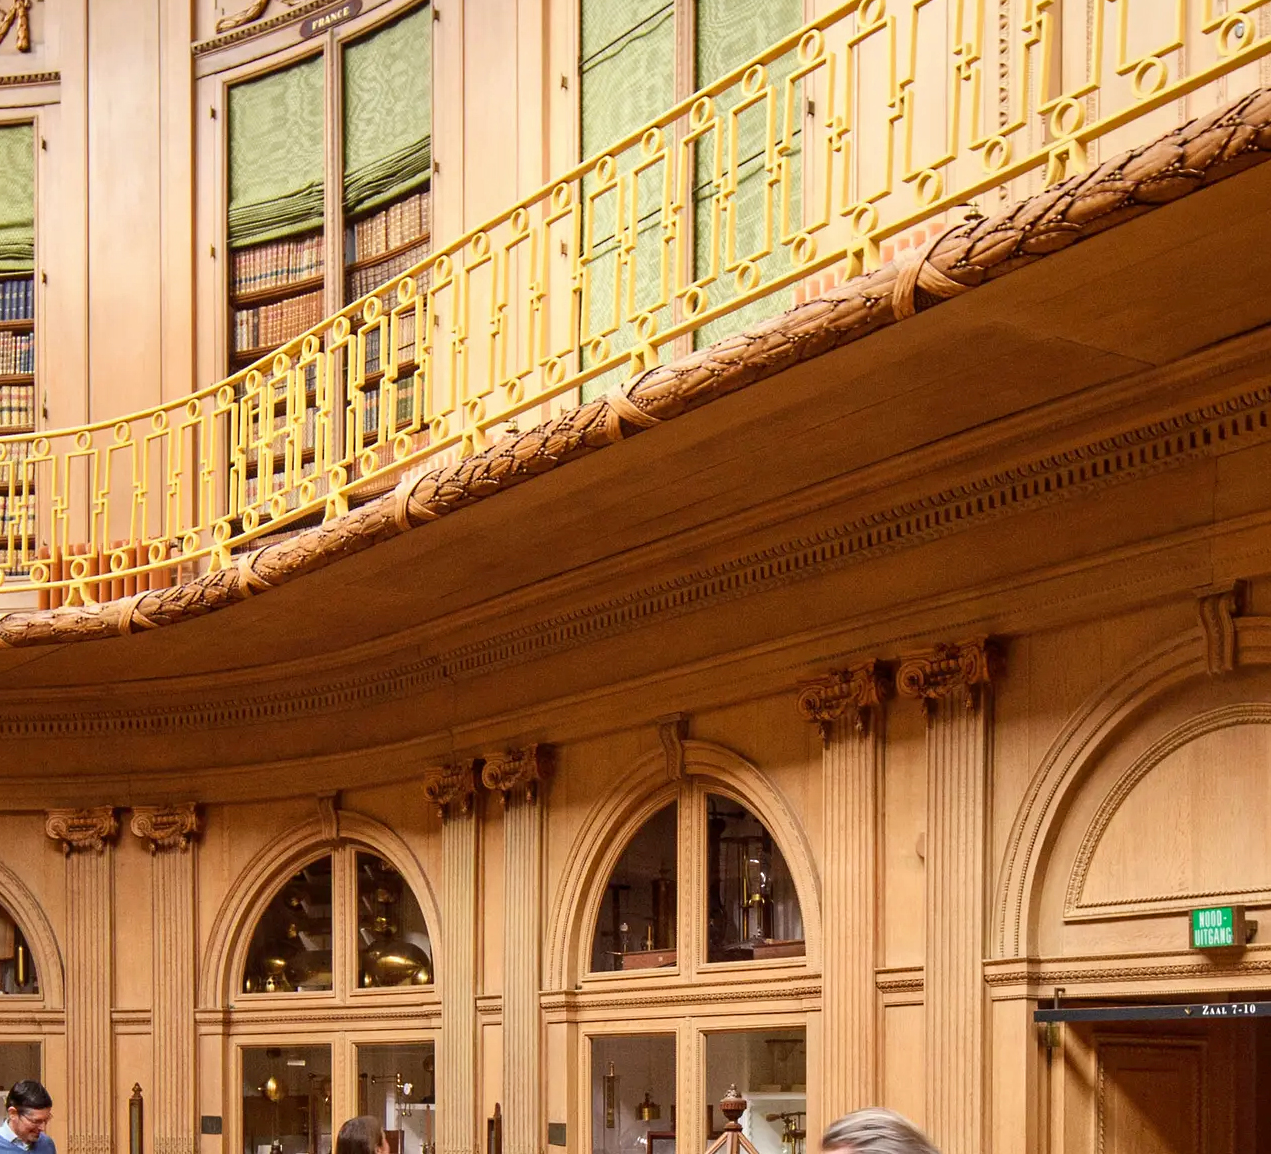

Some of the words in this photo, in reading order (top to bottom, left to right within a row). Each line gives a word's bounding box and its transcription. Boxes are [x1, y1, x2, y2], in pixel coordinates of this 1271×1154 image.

[311, 6, 350, 31] FRANCE
[1198, 909, 1228, 928] NOOD-
[1194, 926, 1233, 946] UITGANG
[1231, 1003, 1257, 1015] 7-10
